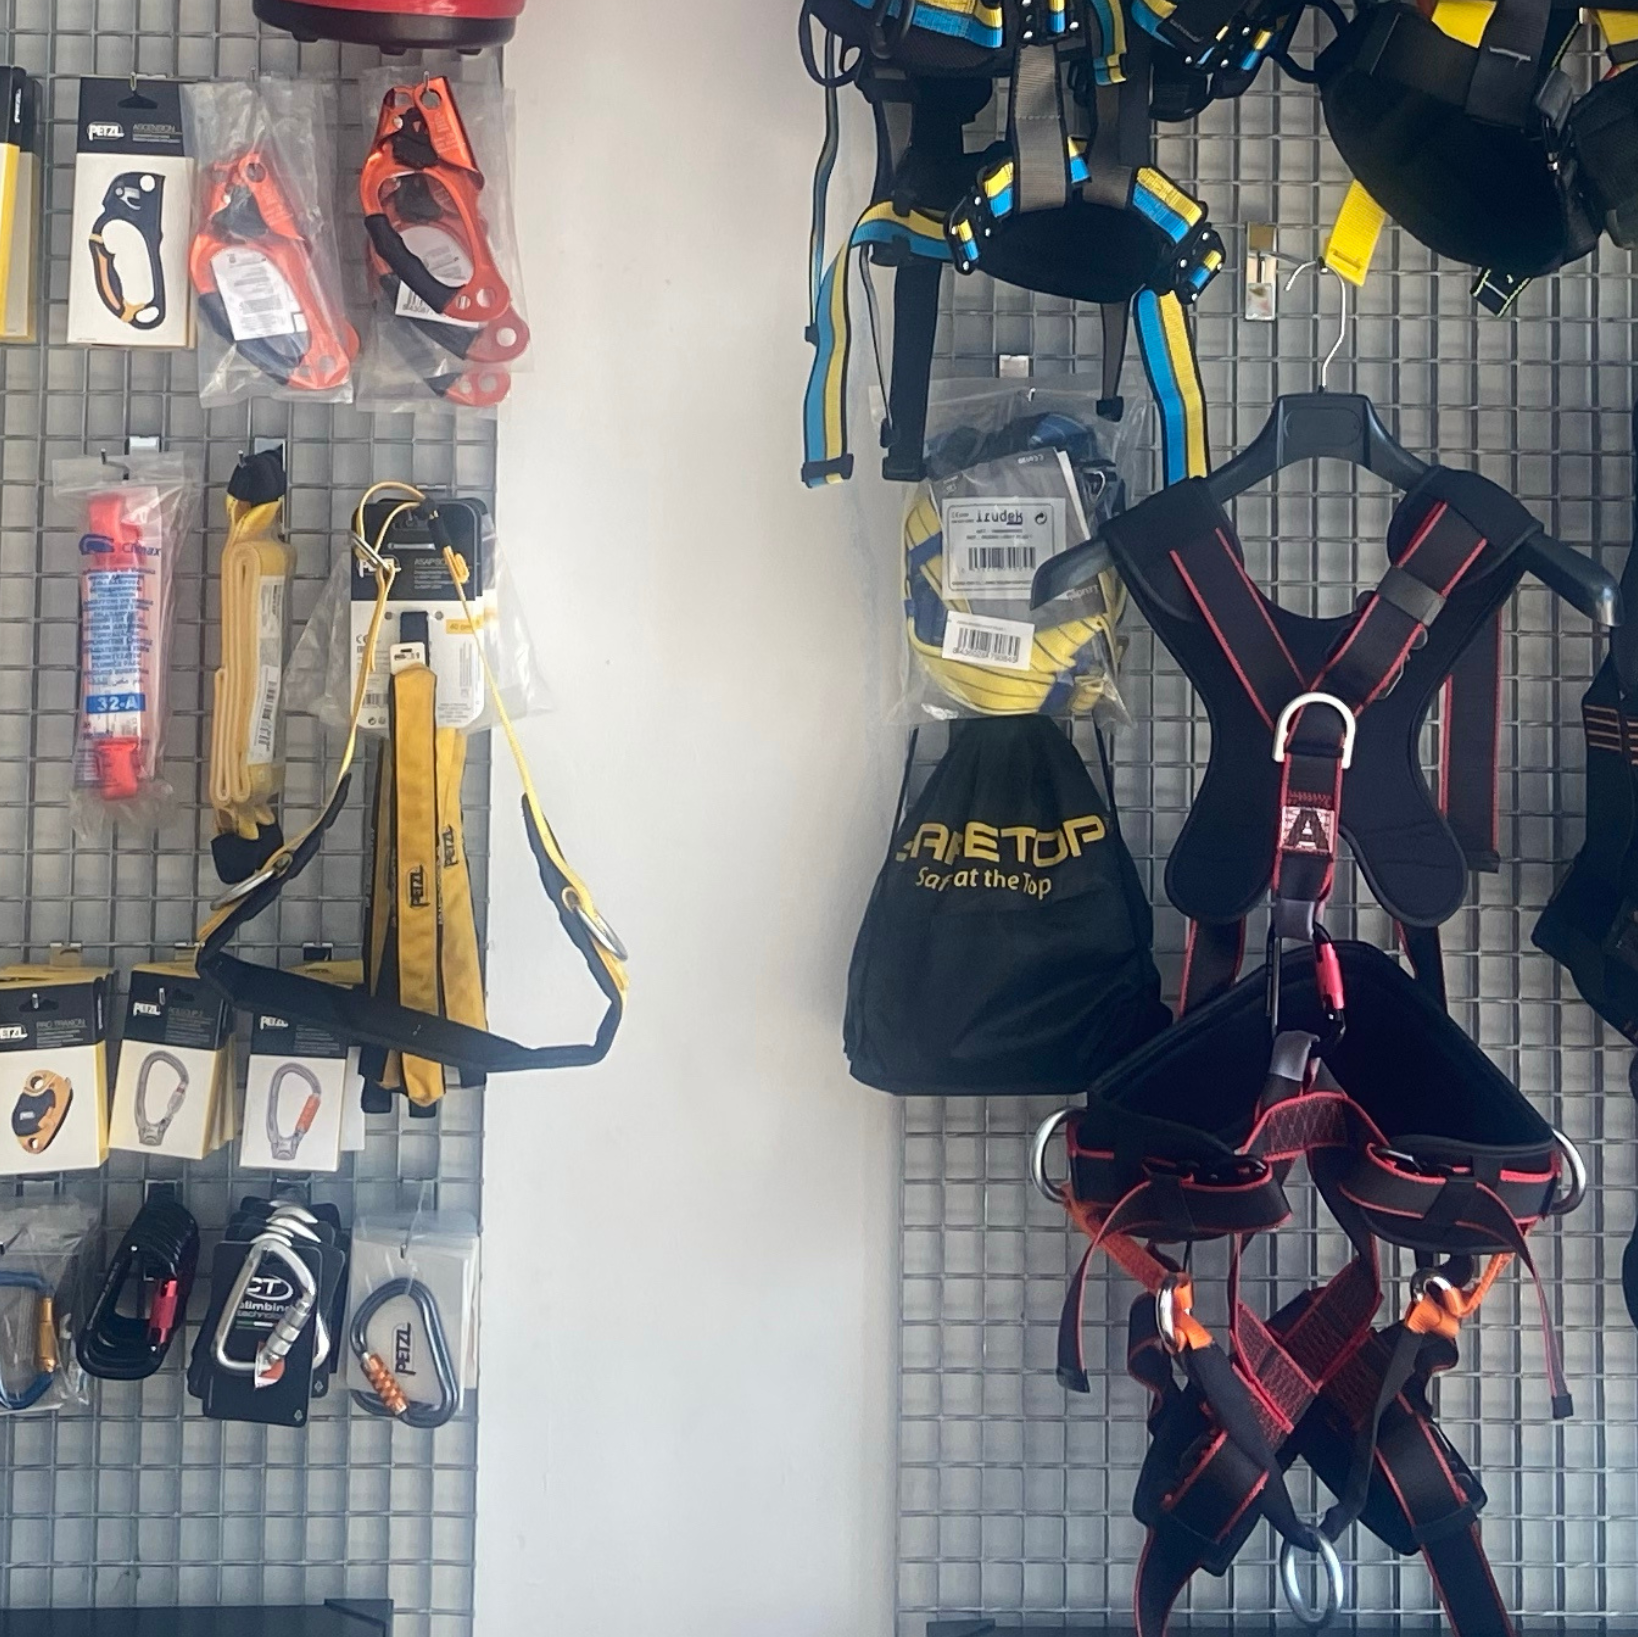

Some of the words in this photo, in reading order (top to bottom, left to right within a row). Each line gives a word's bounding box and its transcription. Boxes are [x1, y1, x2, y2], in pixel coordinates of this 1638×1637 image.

[88, 123, 125, 141] PETZL
[97, 695, 139, 712] 32-A
[410, 865, 430, 908] PETZL
[954, 868, 979, 888] at
[984, 869, 1020, 891] the
[1023, 872, 1052, 900] Top
[396, 1323, 417, 1377] PETZL
